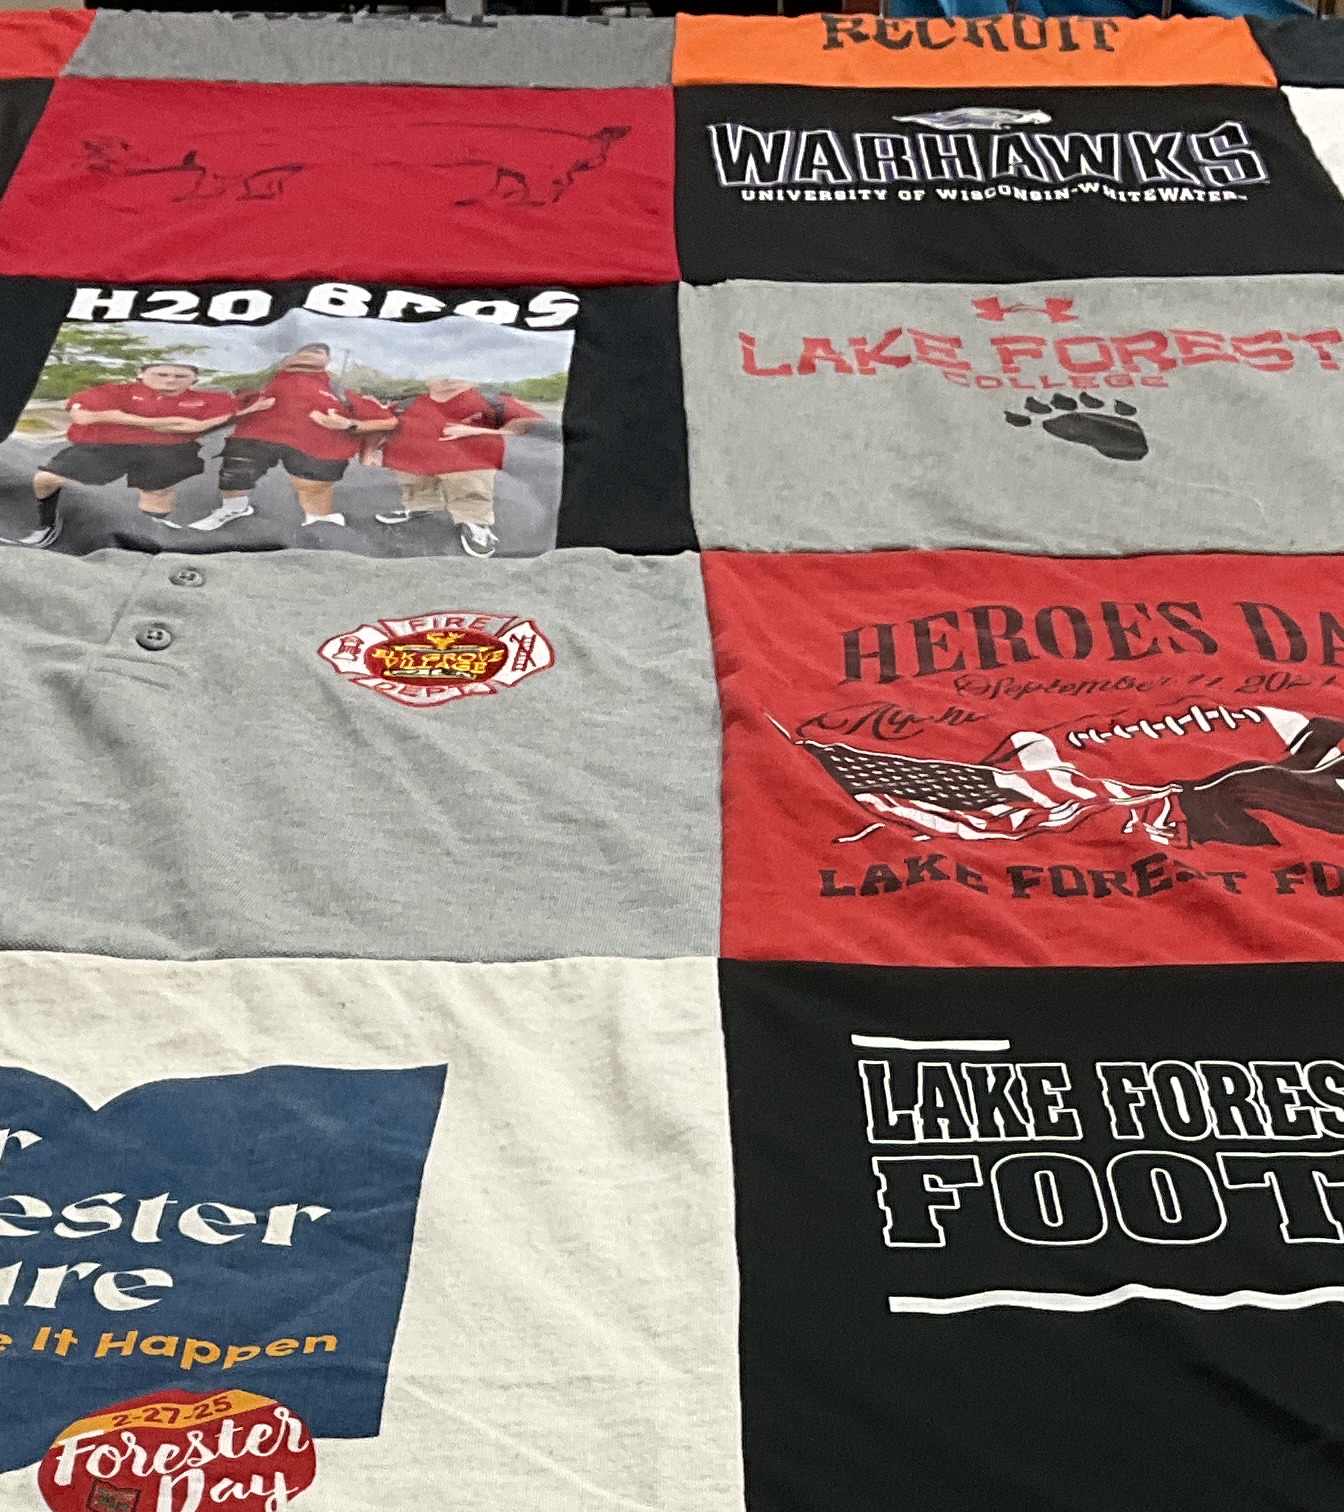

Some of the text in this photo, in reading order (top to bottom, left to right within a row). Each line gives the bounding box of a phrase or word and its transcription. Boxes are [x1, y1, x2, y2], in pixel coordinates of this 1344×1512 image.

[821, 13, 1119, 52] RECRUIT
[707, 120, 1271, 188] WARHAWKS
[741, 189, 888, 202] UNIVERSITY
[898, 189, 925, 201] OF
[738, 327, 1343, 377] LAKE FOREST
[942, 371, 1170, 390] COLLEGE
[409, 616, 490, 632] FIRE
[838, 600, 1220, 686] HEROES
[817, 853, 990, 898] LAKE
[857, 1060, 1083, 1144] LAKE
[31, 1324, 79, 1358] It
[97, 1329, 339, 1371] Happen
[110, 1395, 234, 1429] 2-27-25
[53, 1406, 310, 1487] Forester
